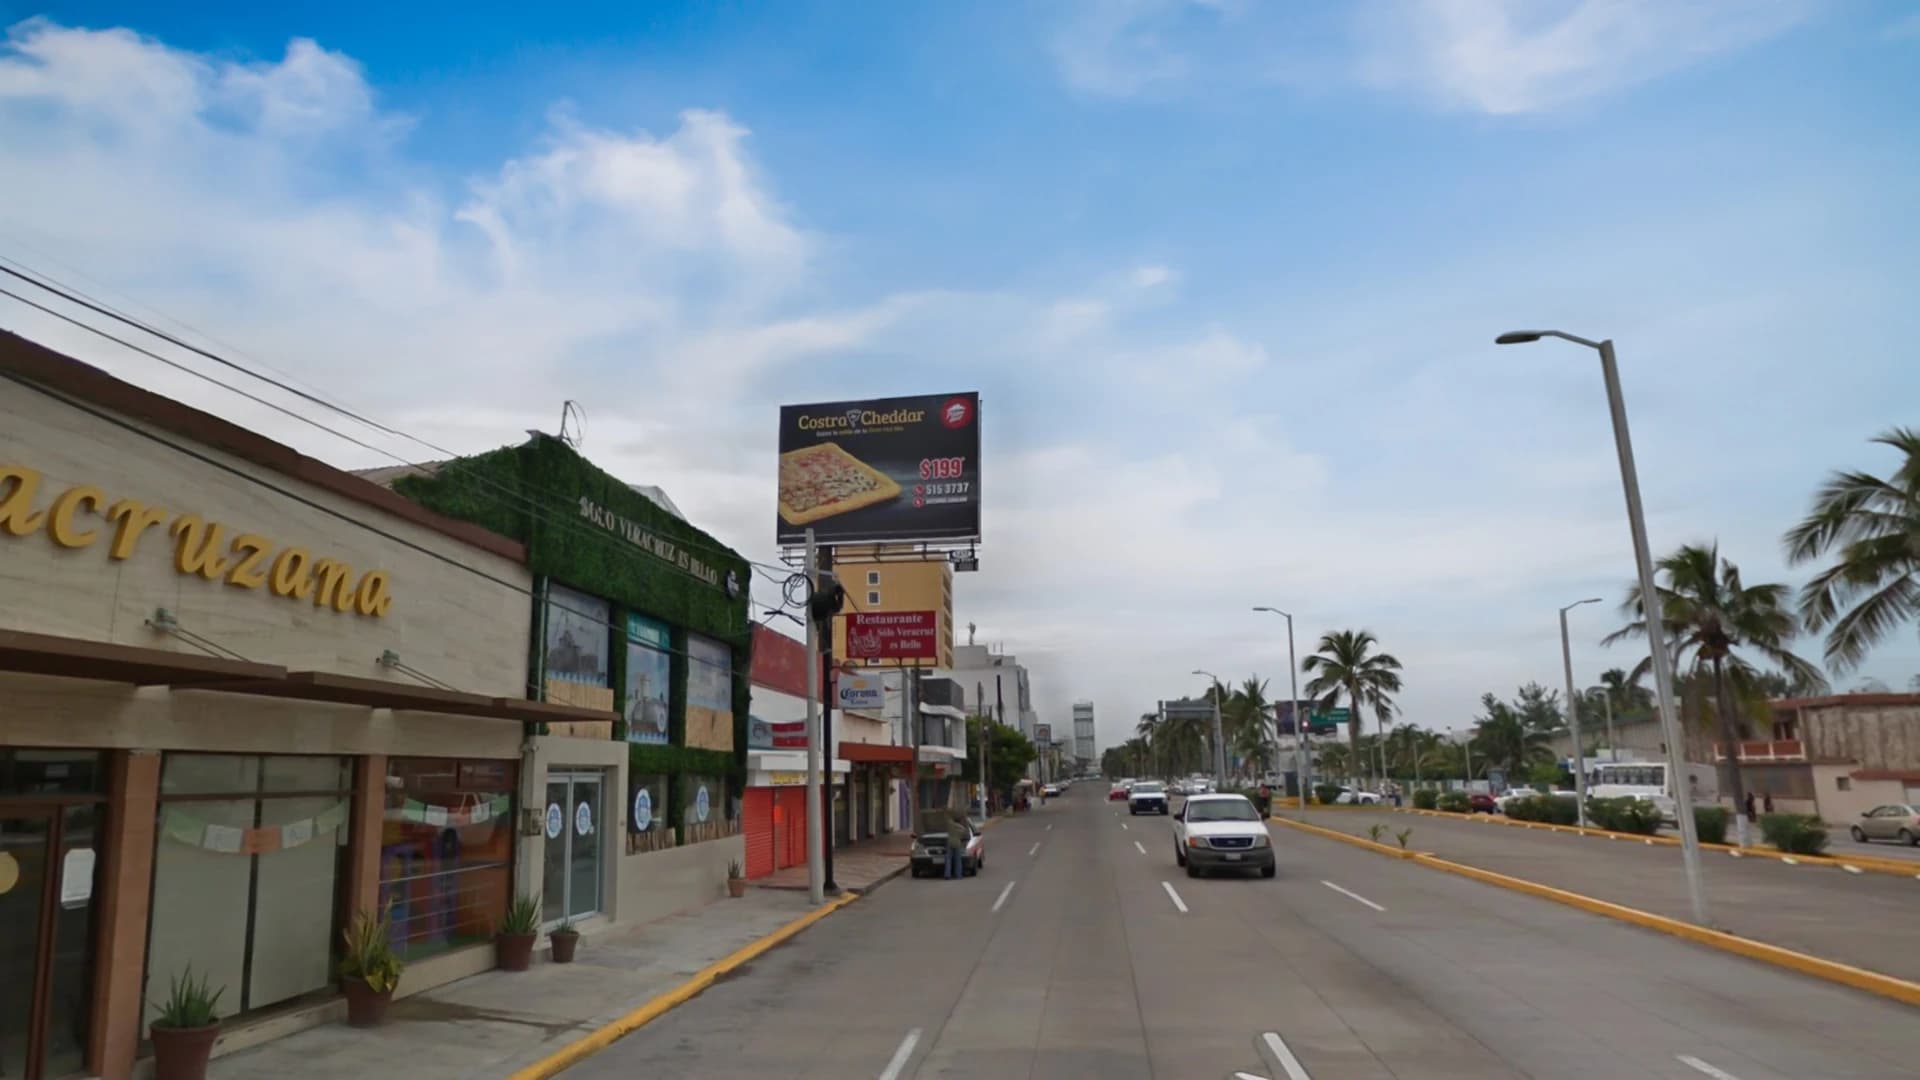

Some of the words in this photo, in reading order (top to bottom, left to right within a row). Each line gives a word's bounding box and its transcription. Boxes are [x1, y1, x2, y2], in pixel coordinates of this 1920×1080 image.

[799, 415, 847, 430] Costra
[861, 409, 925, 426] Cheddar
[926, 484, 943, 495] 515
[944, 482, 969, 494] 3737
[0, 464, 392, 617] acruzana
[856, 614, 923, 625] Restaurante
